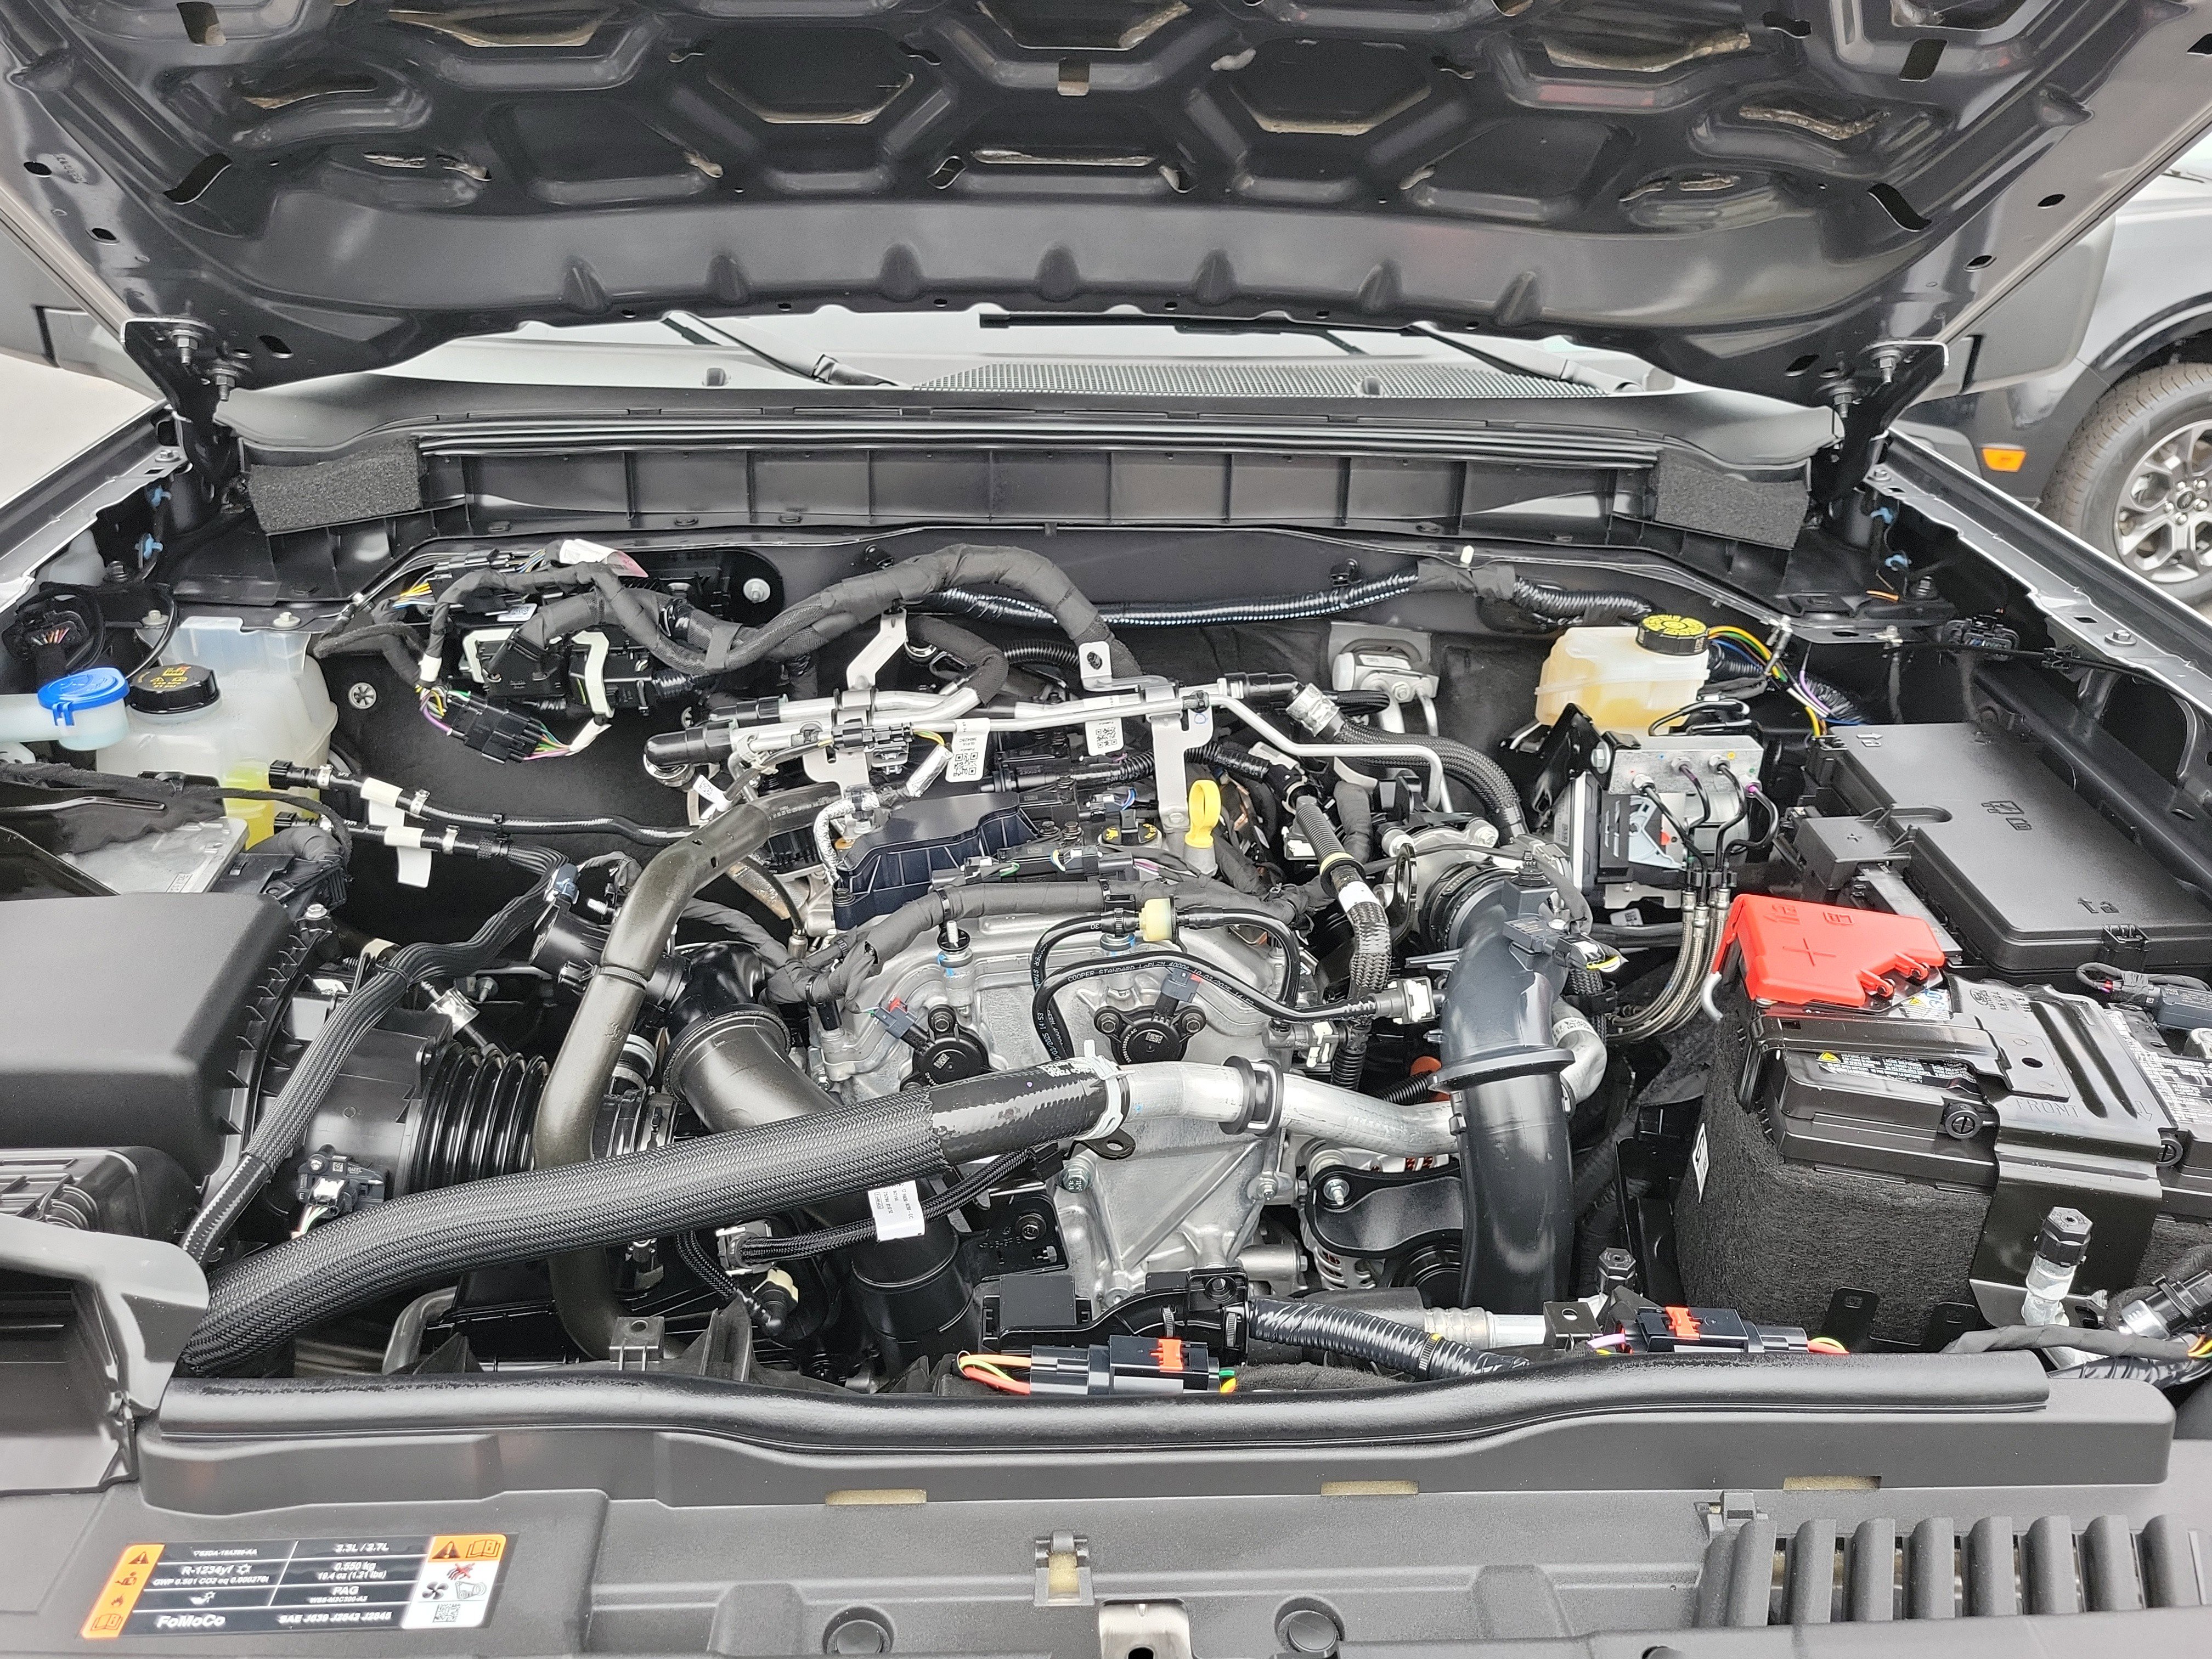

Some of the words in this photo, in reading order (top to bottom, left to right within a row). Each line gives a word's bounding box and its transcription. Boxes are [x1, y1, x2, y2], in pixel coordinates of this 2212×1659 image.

[1068, 970, 1094, 982] COOPER
[1098, 966, 1135, 975] STANDARD
[1042, 1032, 1060, 1060] 0/03/2025
[2016, 1098, 2080, 1118] FRONT
[335, 1543, 358, 1553] 2.3L
[367, 1542, 389, 1551] 2.7L
[180, 1565, 234, 1576] R-1234yf
[335, 1562, 362, 1571] 0.550
[364, 1561, 376, 1572] kg
[332, 1586, 359, 1595] PAG
[156, 1615, 225, 1628] FoMoCo
[278, 1614, 302, 1624] SAE
